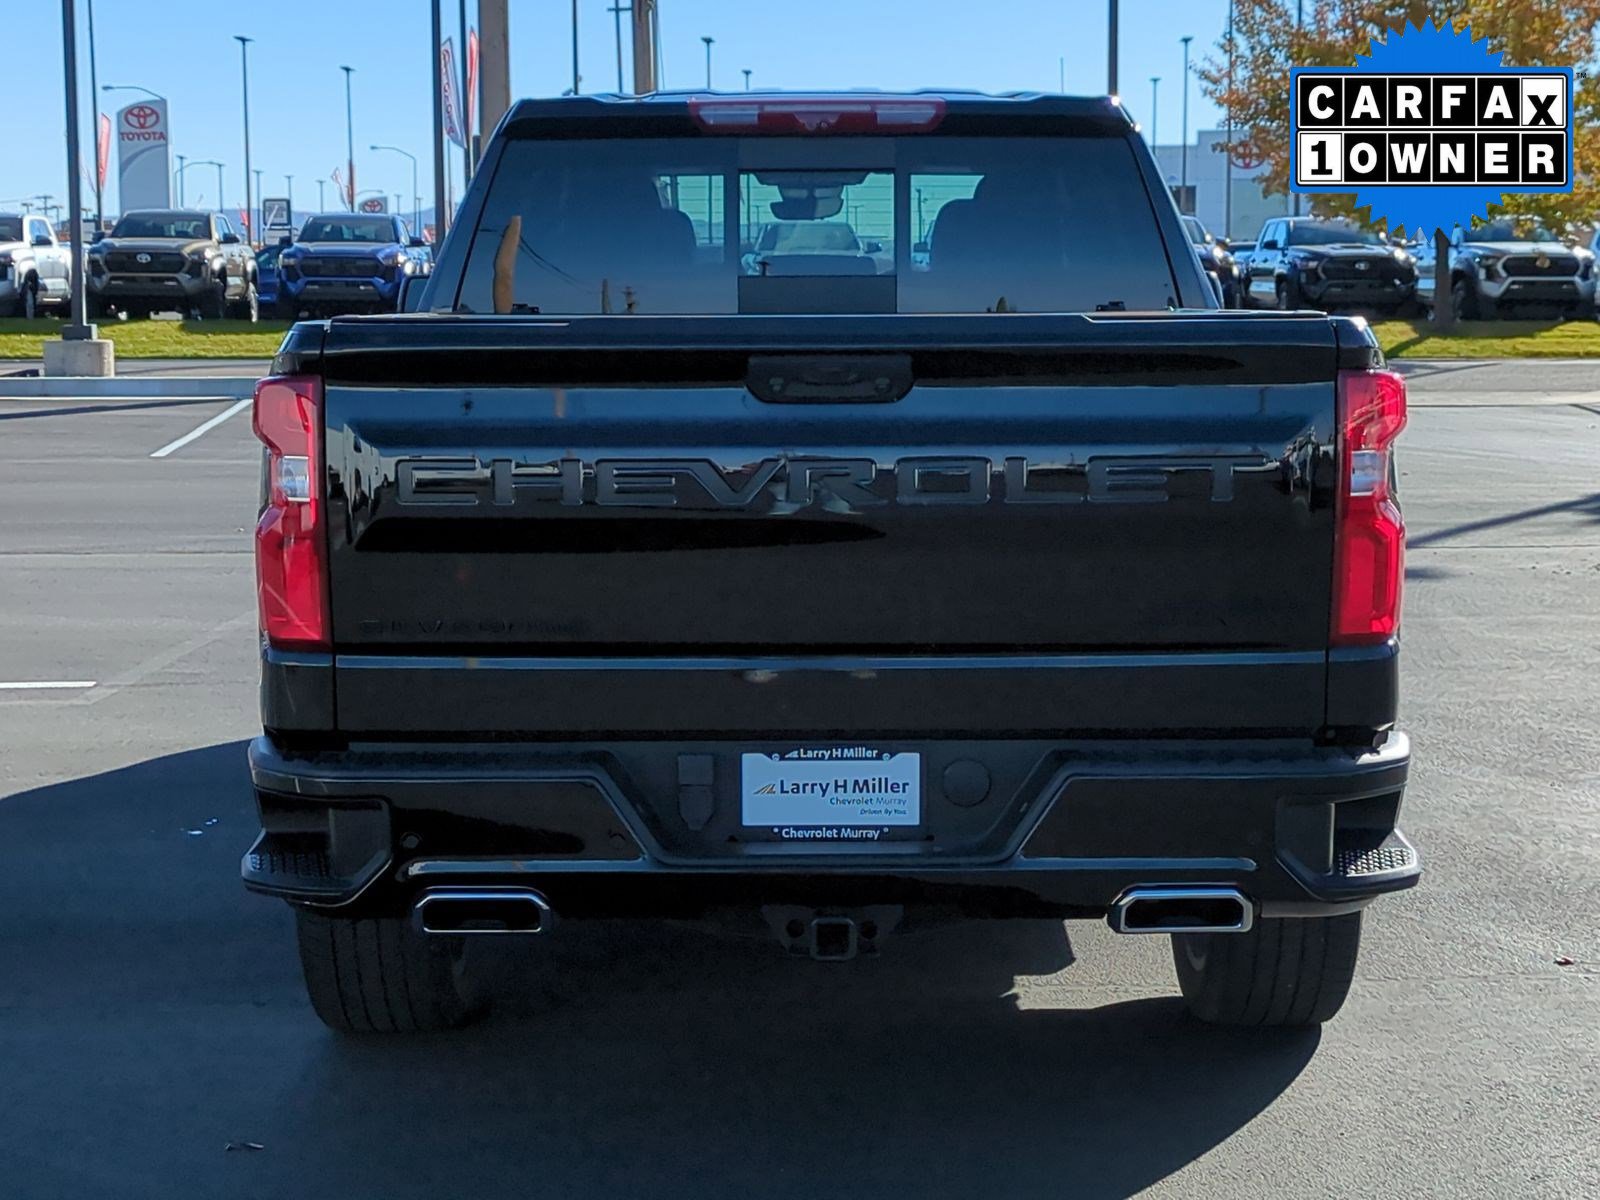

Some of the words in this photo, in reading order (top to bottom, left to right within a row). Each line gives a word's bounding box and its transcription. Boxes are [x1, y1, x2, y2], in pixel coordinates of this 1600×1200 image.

[120, 131, 166, 141] TOYOTA
[395, 455, 1268, 505] CHEVROLET
[800, 748, 831, 760] Larry
[832, 748, 842, 758] H
[843, 747, 878, 758] Miller
[779, 779, 830, 798] Larry
[834, 779, 848, 794] H
[852, 777, 910, 794] Miller
[829, 796, 873, 806] Chevrolet
[875, 797, 907, 806] Murray
[781, 827, 838, 838] Chevrolet
[840, 827, 880, 841] Murray
